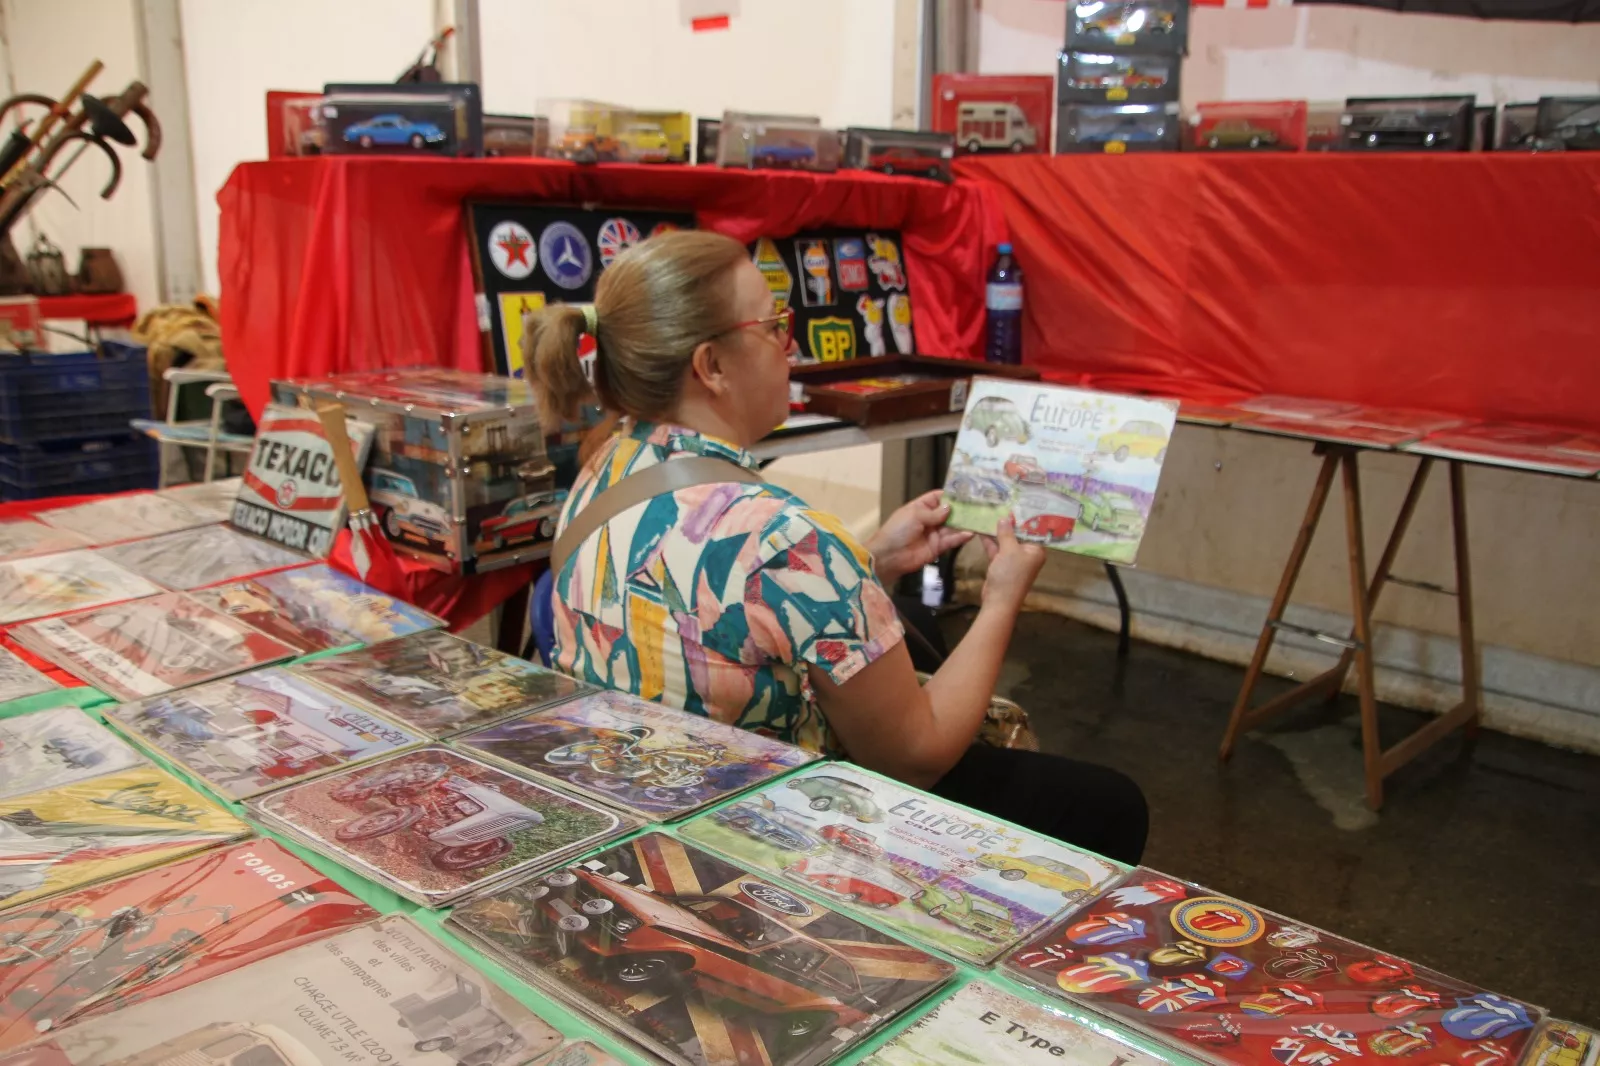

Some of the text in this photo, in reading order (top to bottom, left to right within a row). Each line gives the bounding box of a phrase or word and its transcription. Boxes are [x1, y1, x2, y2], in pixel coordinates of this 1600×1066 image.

[819, 330, 851, 361] BP
[237, 852, 295, 890] TOMOS
[753, 889, 796, 909] Ford
[324, 941, 392, 999] des campagnes
[368, 957, 383, 967] et
[373, 938, 415, 972] des villes
[293, 976, 338, 1013] CHARGE
[331, 1011, 368, 1040] UTILE
[294, 1004, 336, 1039] VOLUME
[978, 1010, 1066, 1057] E Type
